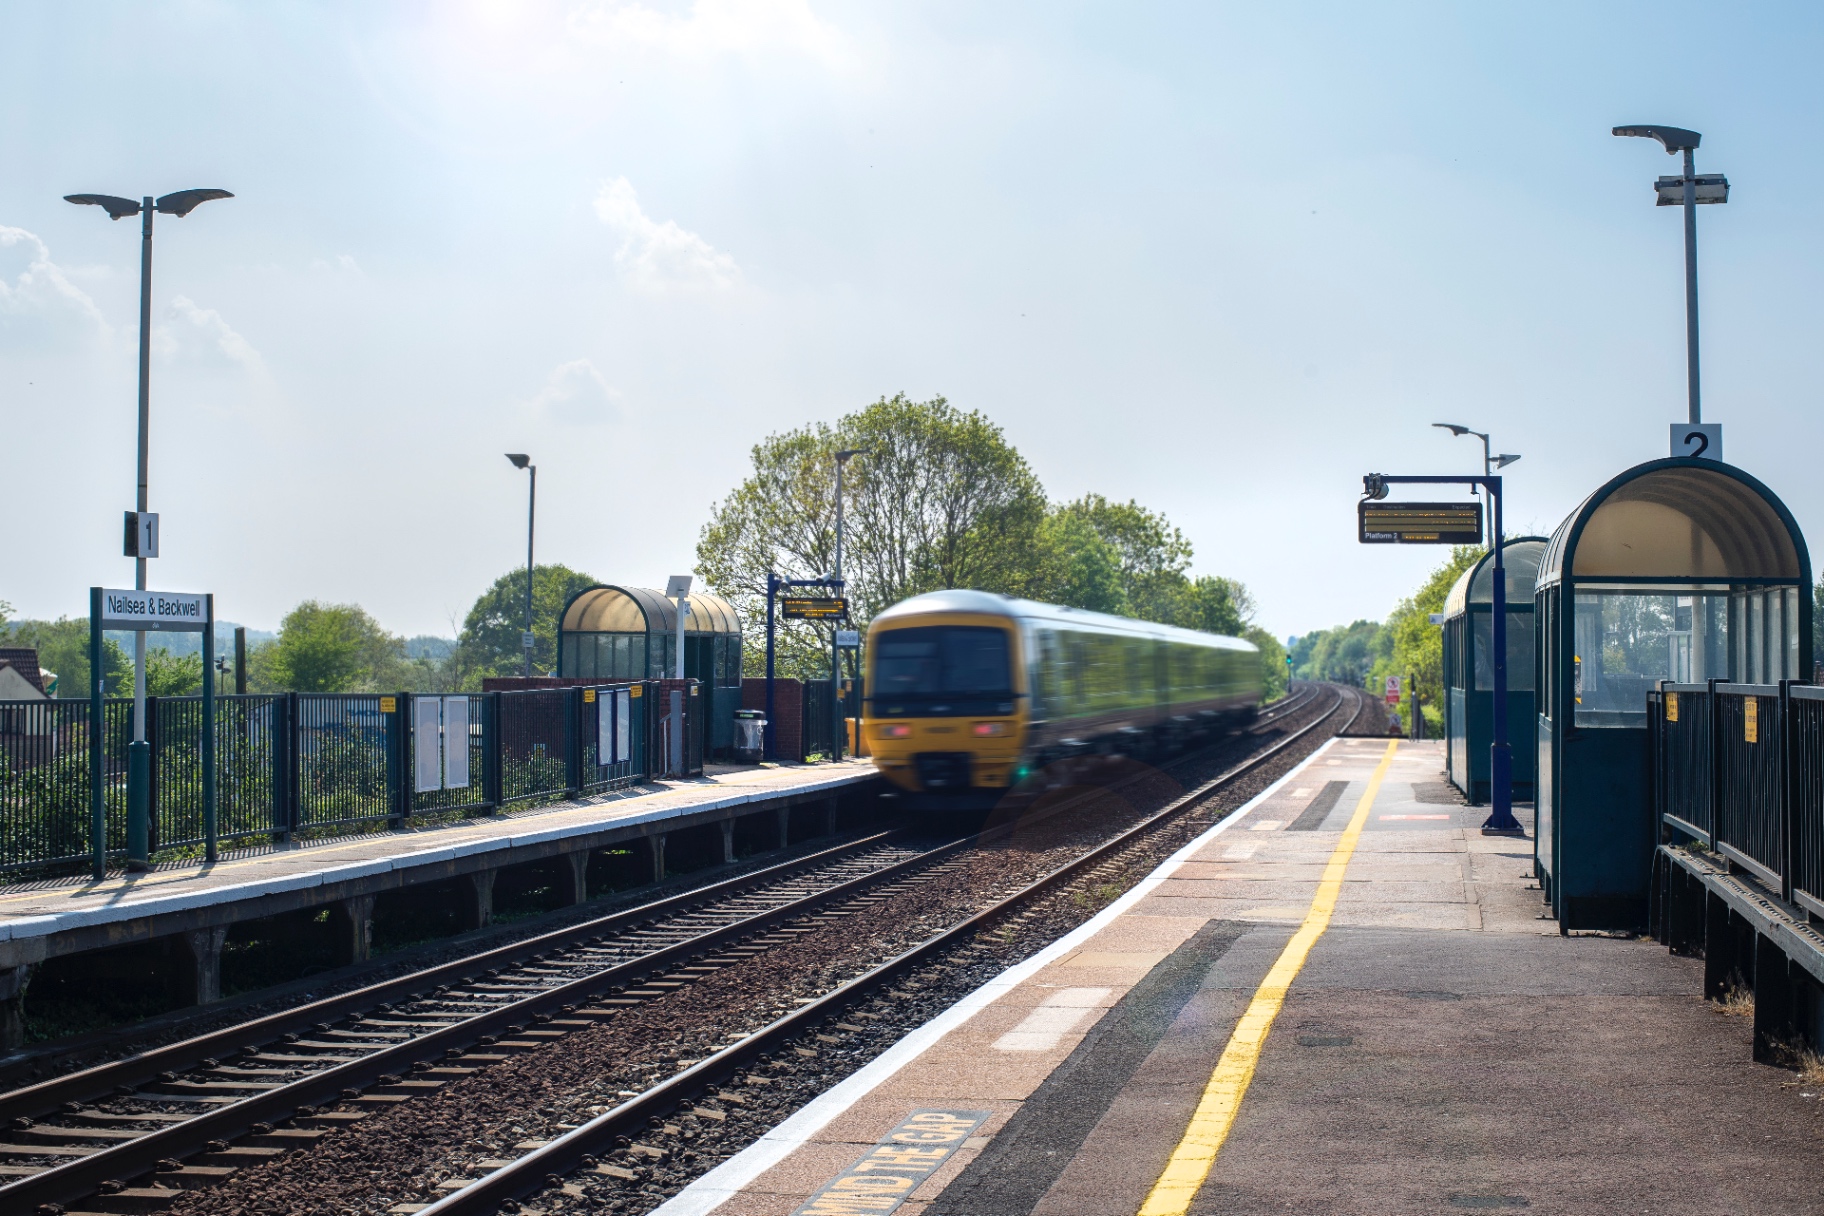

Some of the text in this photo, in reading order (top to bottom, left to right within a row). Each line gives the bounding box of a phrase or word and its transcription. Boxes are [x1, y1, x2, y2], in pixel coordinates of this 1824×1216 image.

[1683, 431, 1709, 457] 2
[145, 520, 152, 551] 1
[1364, 532, 1393, 540] Platform
[1393, 532, 1398, 540] 2
[108, 595, 200, 617] Nailsea & Backwell
[801, 1112, 977, 1216] MIND THE GAP
